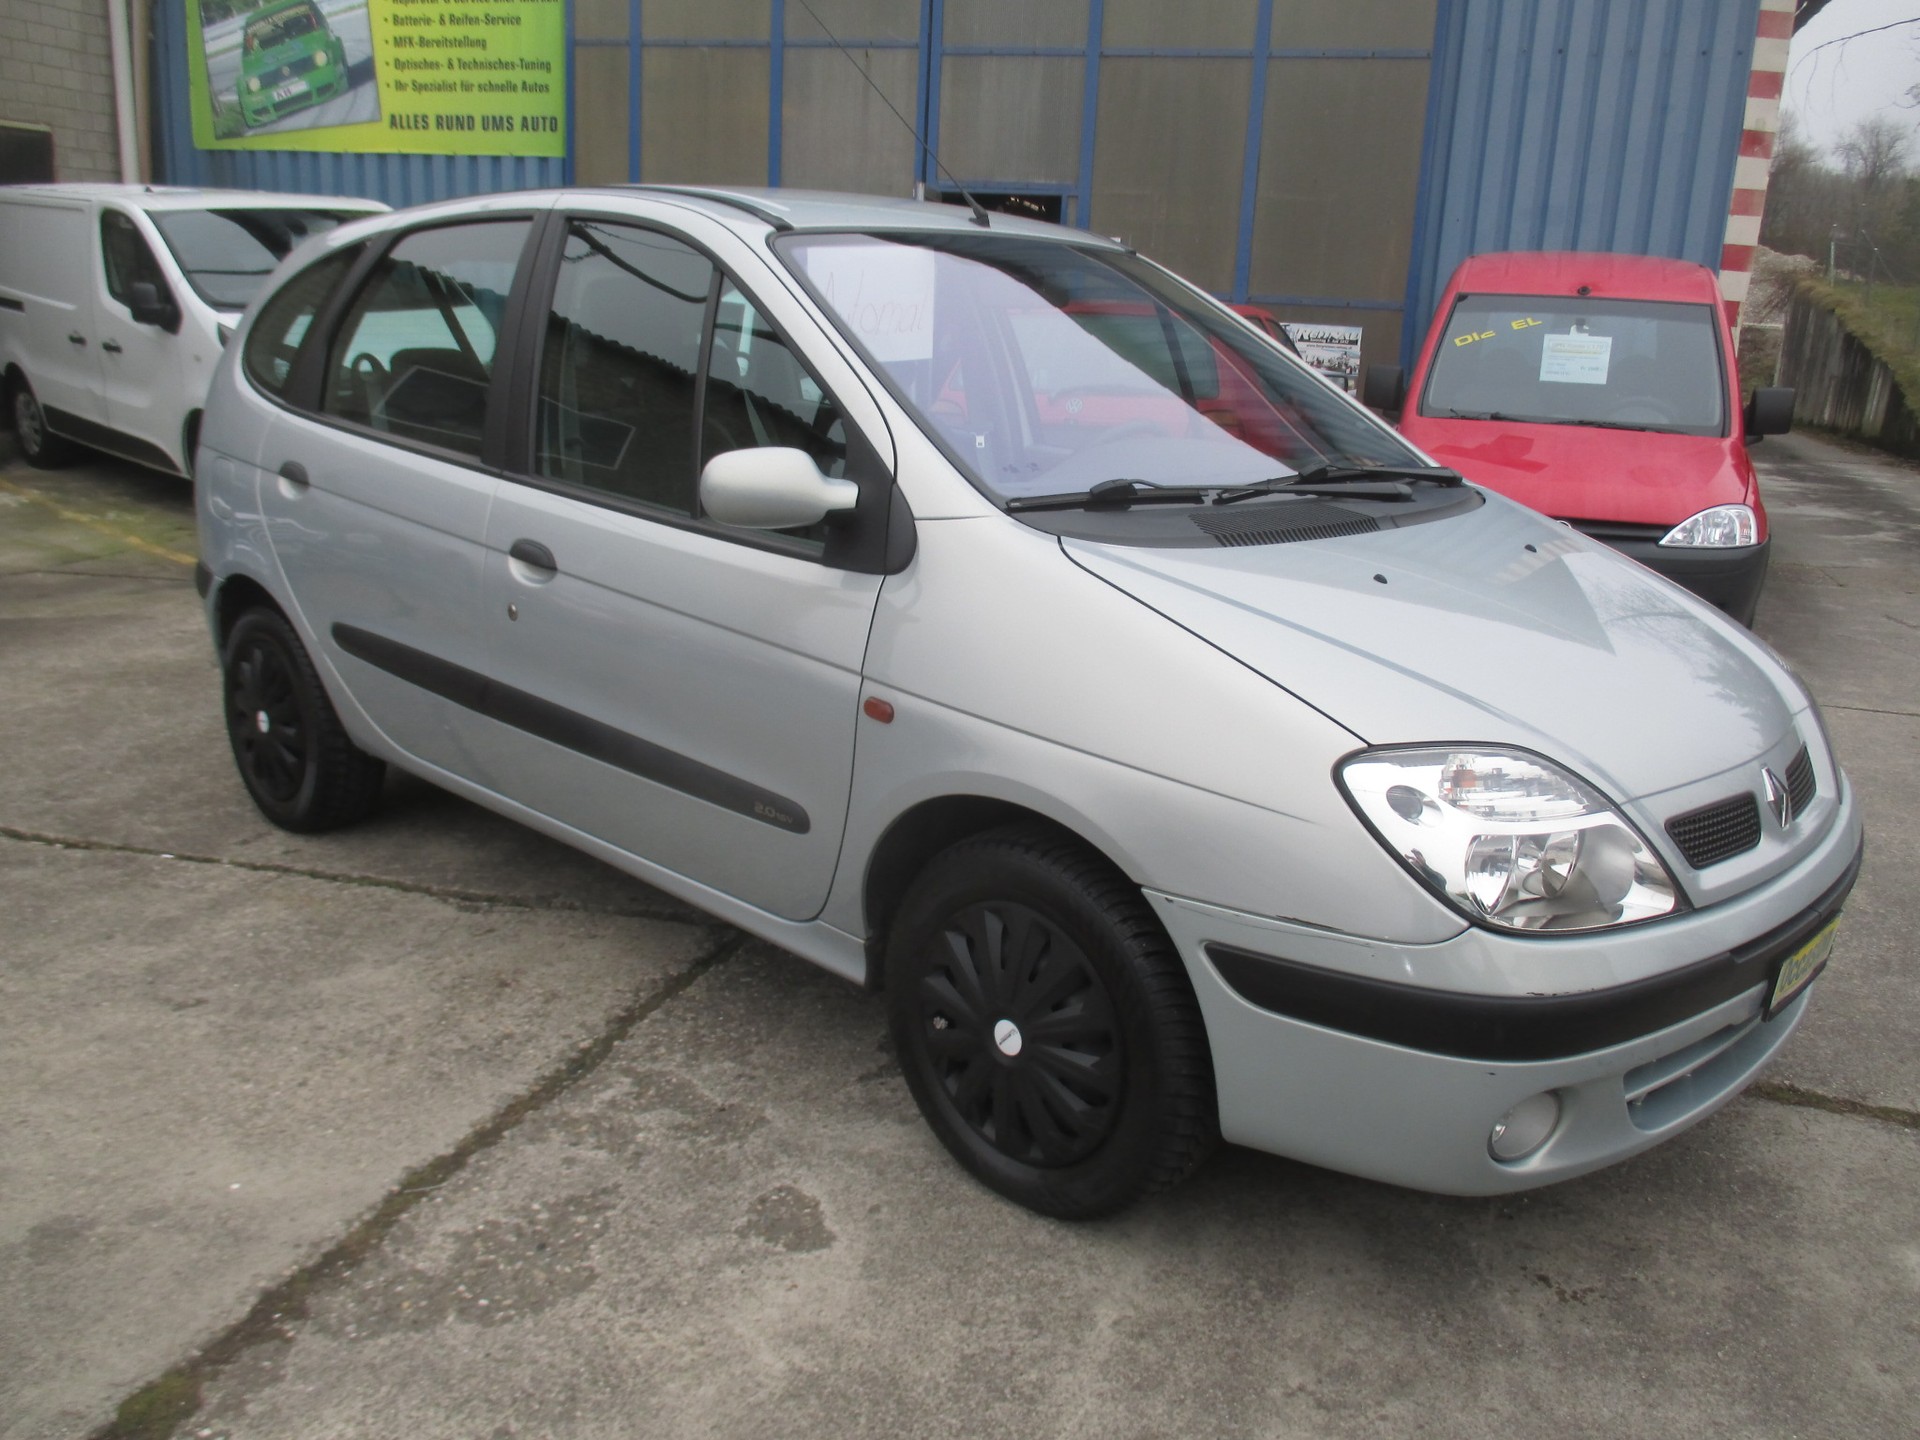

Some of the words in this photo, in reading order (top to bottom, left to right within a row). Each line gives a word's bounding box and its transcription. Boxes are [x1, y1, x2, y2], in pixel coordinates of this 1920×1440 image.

[392, 12, 436, 26] Batterie-
[439, 13, 447, 26] &
[449, 12, 522, 26] Reifen-Service
[392, 35, 487, 50] MFK-Bereitstellung
[394, 57, 444, 72] Optisches-
[447, 58, 454, 71] &
[457, 57, 552, 73] Technisches-Tuning
[395, 80, 409, 92] Ihr
[411, 79, 457, 95] Spezialist
[460, 79, 475, 93] für
[478, 79, 518, 93] schnelle
[521, 80, 550, 93] Autos
[389, 113, 429, 130] ALLES
[435, 114, 475, 131] RUND
[481, 115, 514, 132] UMS
[520, 115, 559, 132] AUTO
